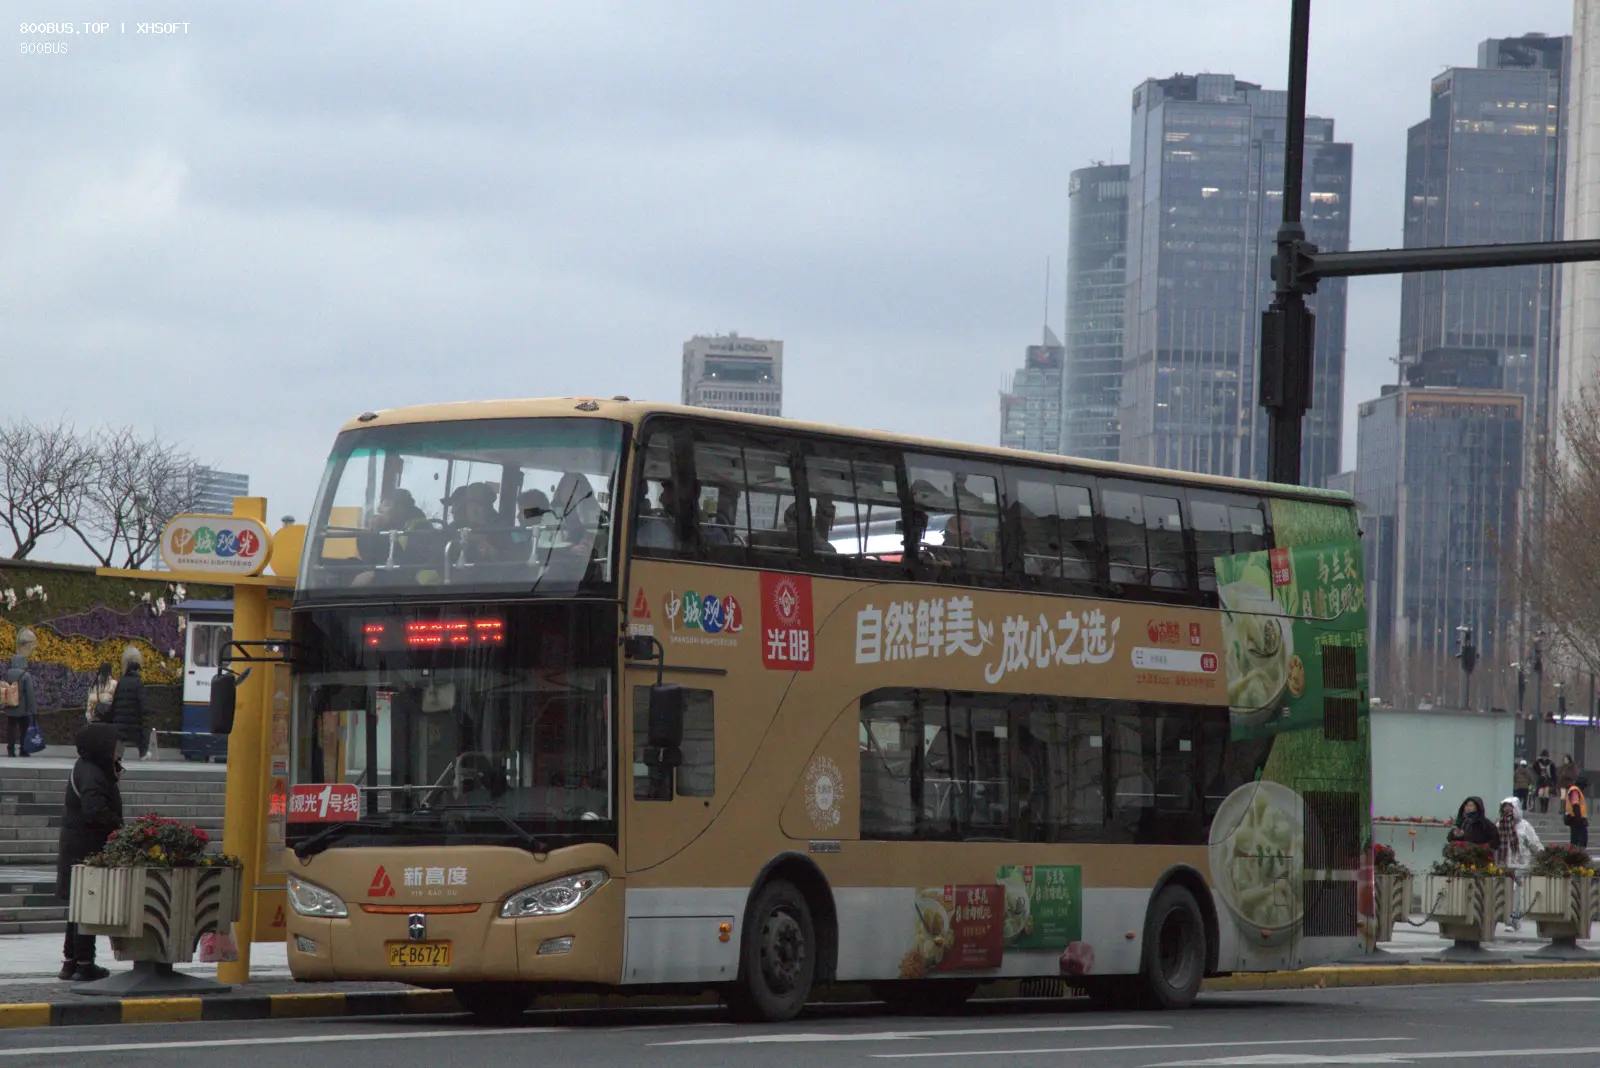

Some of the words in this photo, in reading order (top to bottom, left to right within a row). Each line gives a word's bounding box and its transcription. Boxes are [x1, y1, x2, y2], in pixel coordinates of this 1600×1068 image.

[174, 526, 257, 557] 申城观光
[664, 590, 744, 634] 申城观光
[767, 628, 810, 662] 光明
[855, 596, 983, 664] 自然鲜美
[984, 608, 1121, 684] 放心之选
[403, 866, 468, 886] 新高度
